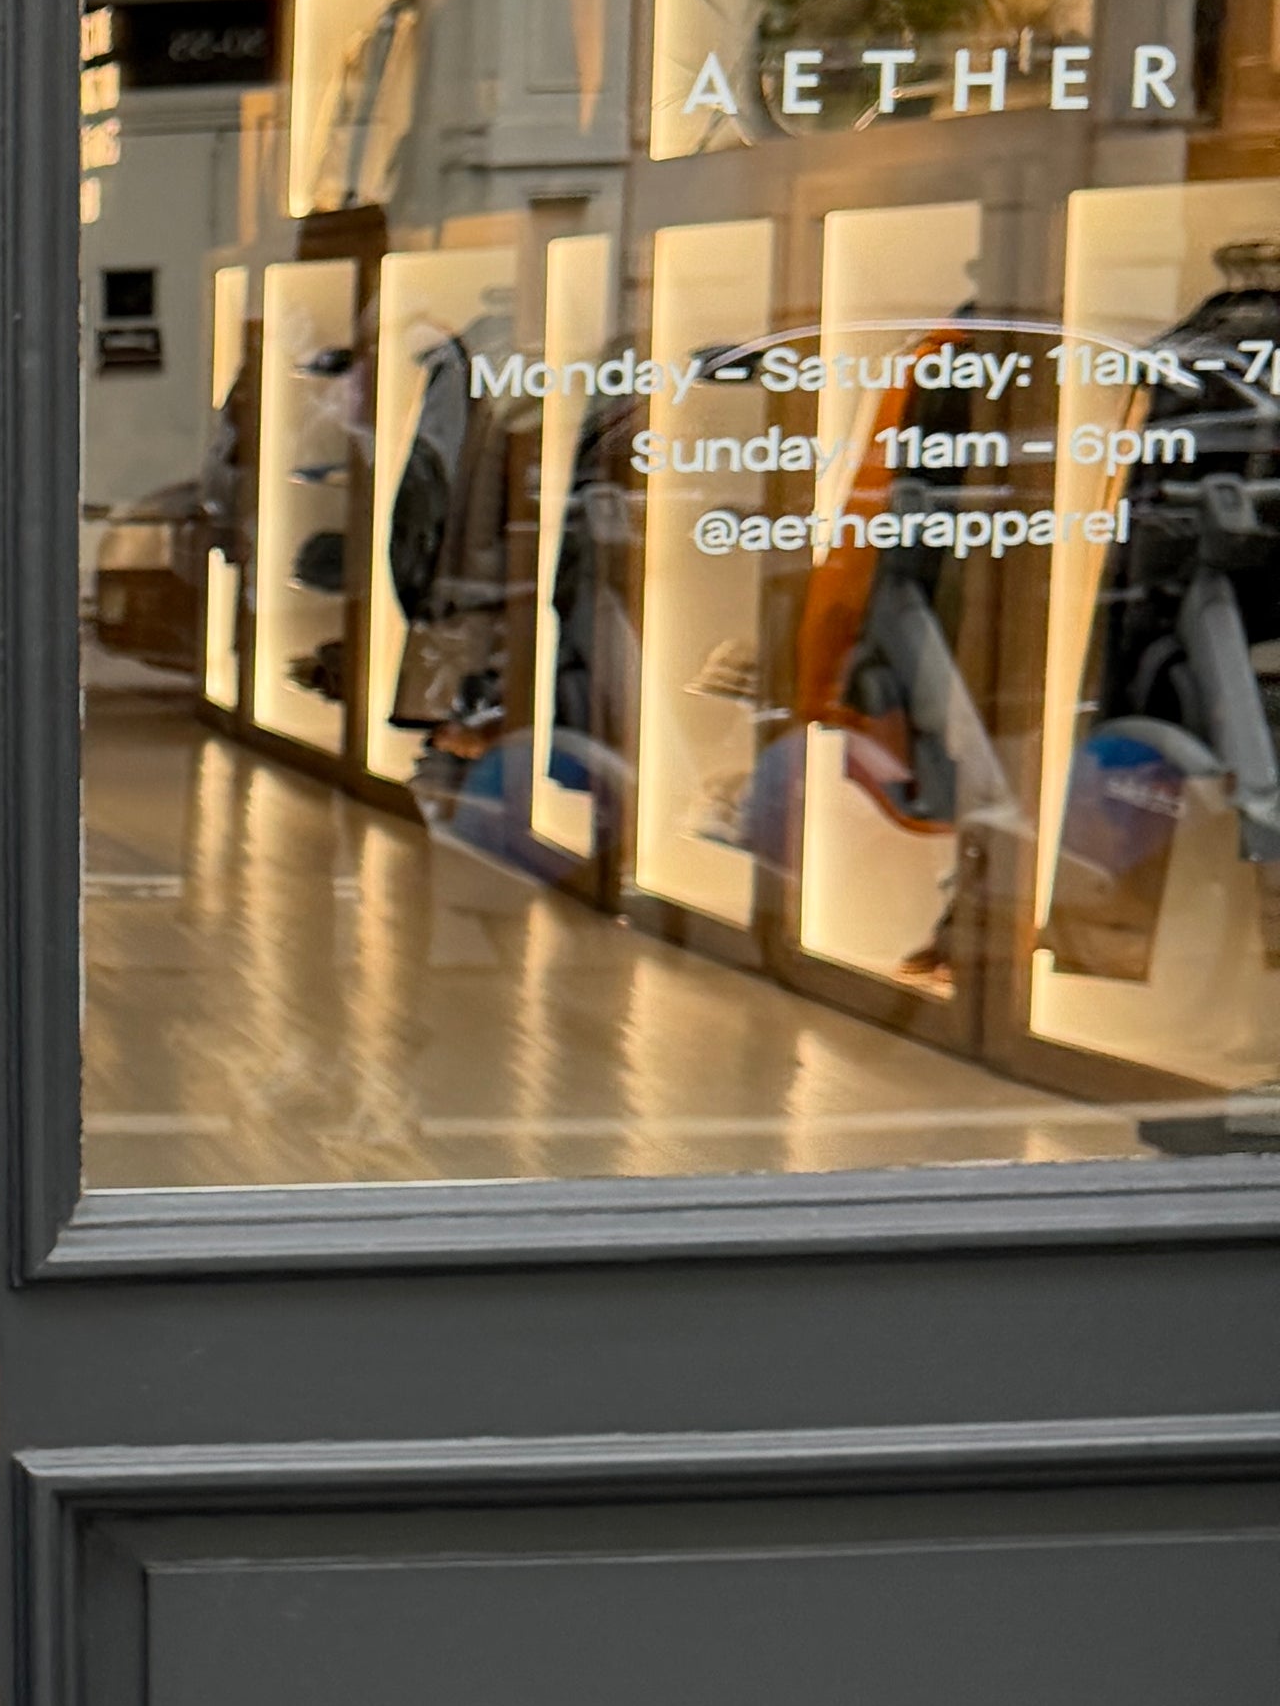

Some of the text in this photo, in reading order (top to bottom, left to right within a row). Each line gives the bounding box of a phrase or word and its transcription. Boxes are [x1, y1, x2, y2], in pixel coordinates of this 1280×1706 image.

[684, 45, 1177, 114] AETHER
[471, 348, 700, 405] Monday
[761, 344, 1032, 400] Saturday:
[1047, 343, 1182, 386] 11am
[630, 425, 859, 481] Sunday:
[874, 423, 1008, 469] 11am
[1070, 423, 1197, 477] 6pm
[694, 499, 1131, 556] @aetherapparel
